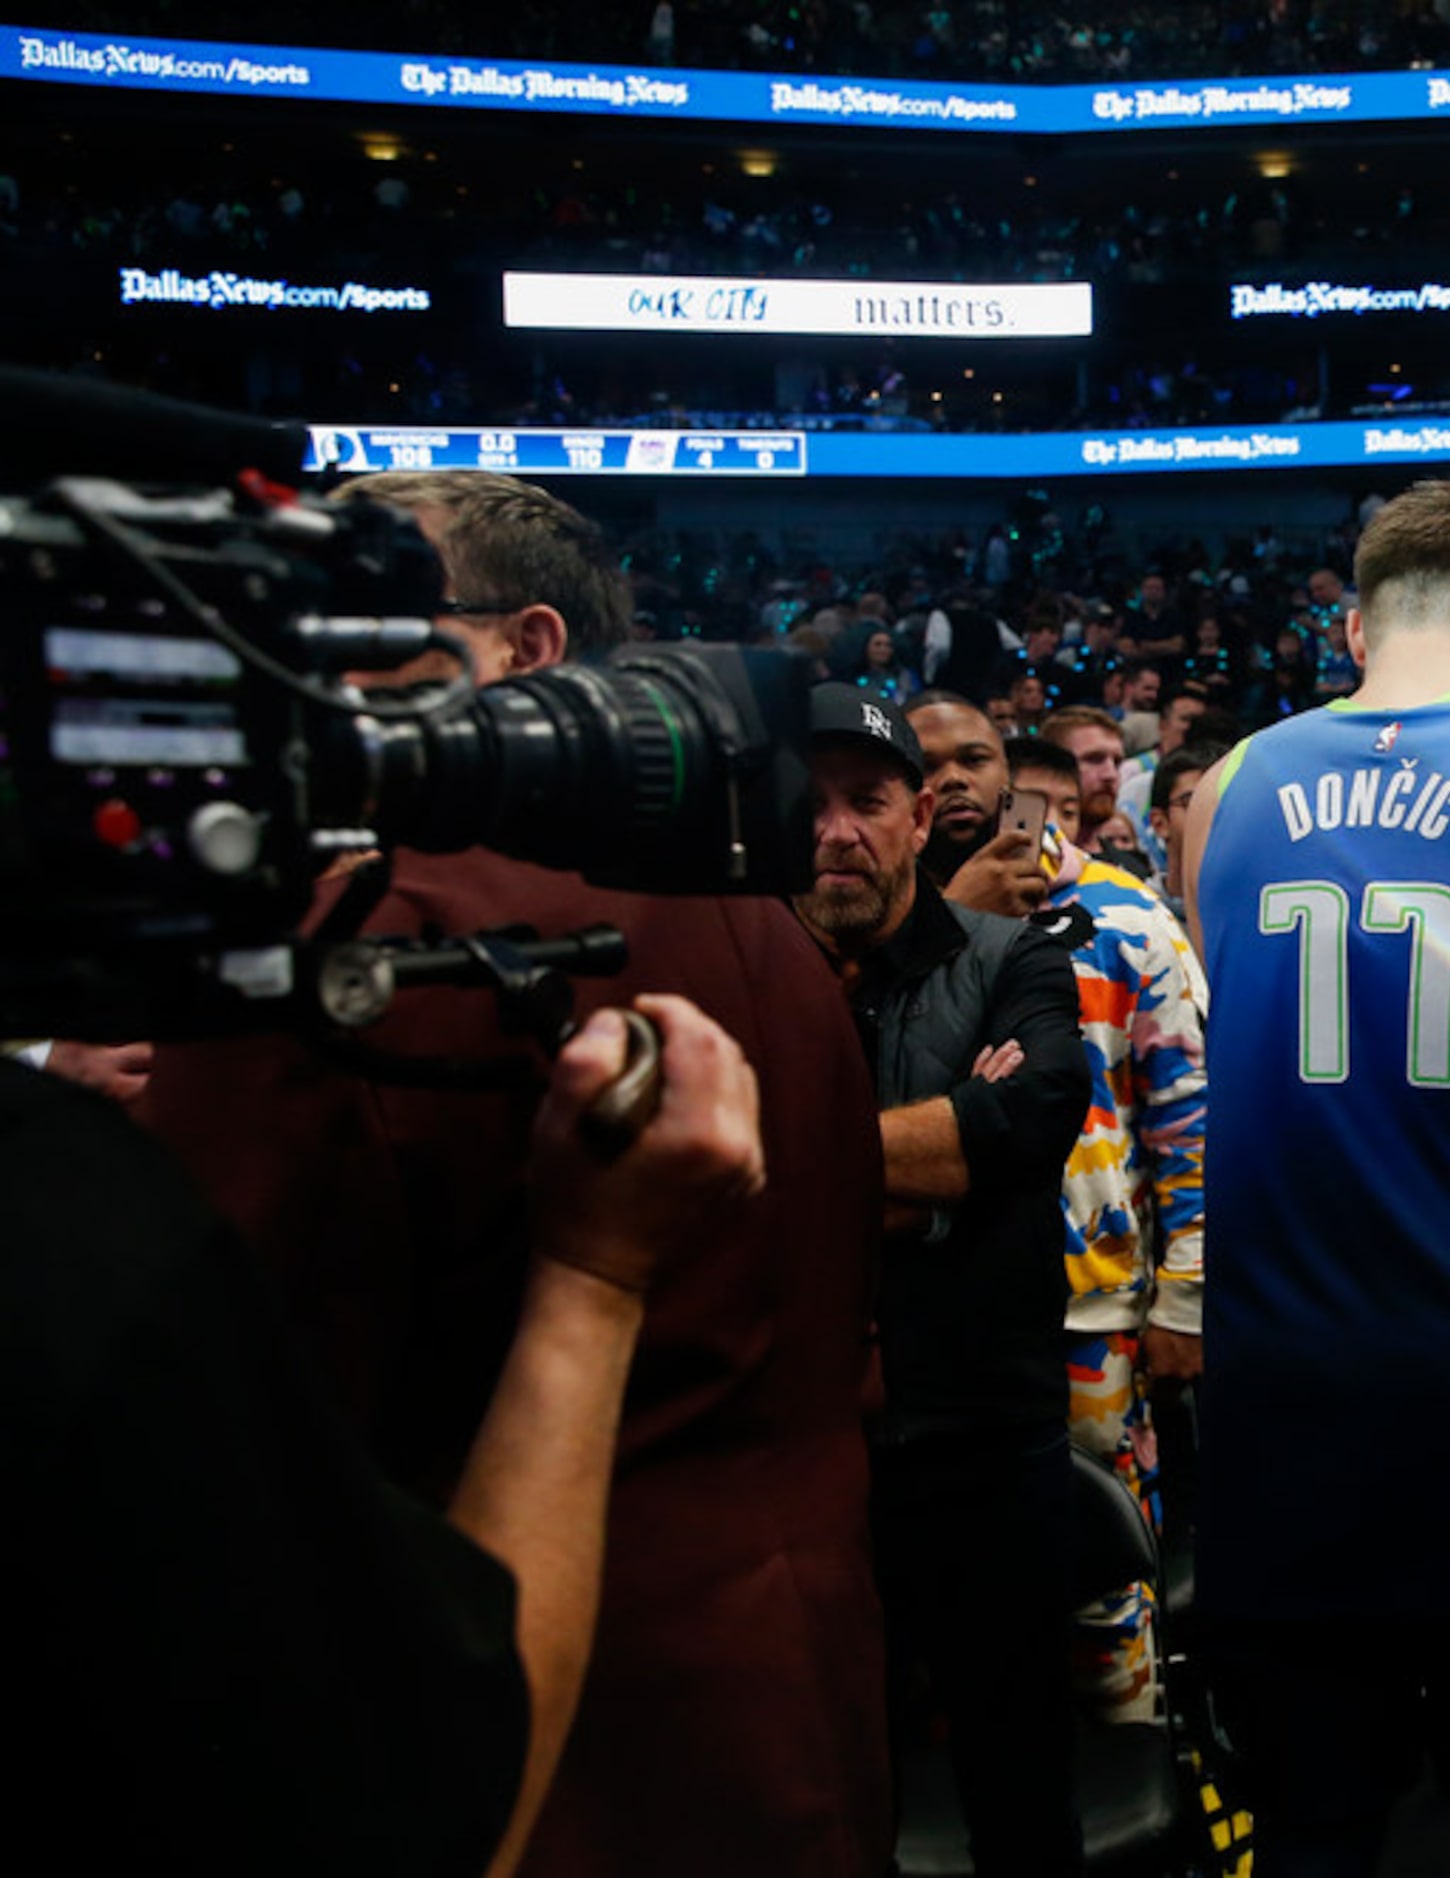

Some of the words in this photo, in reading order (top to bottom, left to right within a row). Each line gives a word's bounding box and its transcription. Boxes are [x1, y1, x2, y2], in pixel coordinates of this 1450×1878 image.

[20, 37, 309, 84] DallasNews.com/Sports
[401, 64, 446, 95] The
[449, 66, 524, 96] Dallas
[524, 70, 624, 105] Morning
[624, 75, 688, 105] News
[771, 83, 1016, 120] DallasNews.com/Sports
[1093, 91, 1134, 120] The
[1135, 89, 1202, 118] Dallas
[1202, 86, 1293, 117] Morning
[1293, 84, 1350, 113] News
[122, 269, 429, 310] DallasNews.com/Sports
[854, 295, 1017, 328] matters.
[1082, 440, 1116, 464] The
[1117, 438, 1173, 462] Dallas
[1173, 436, 1250, 461] Morning
[1250, 434, 1300, 458] News
